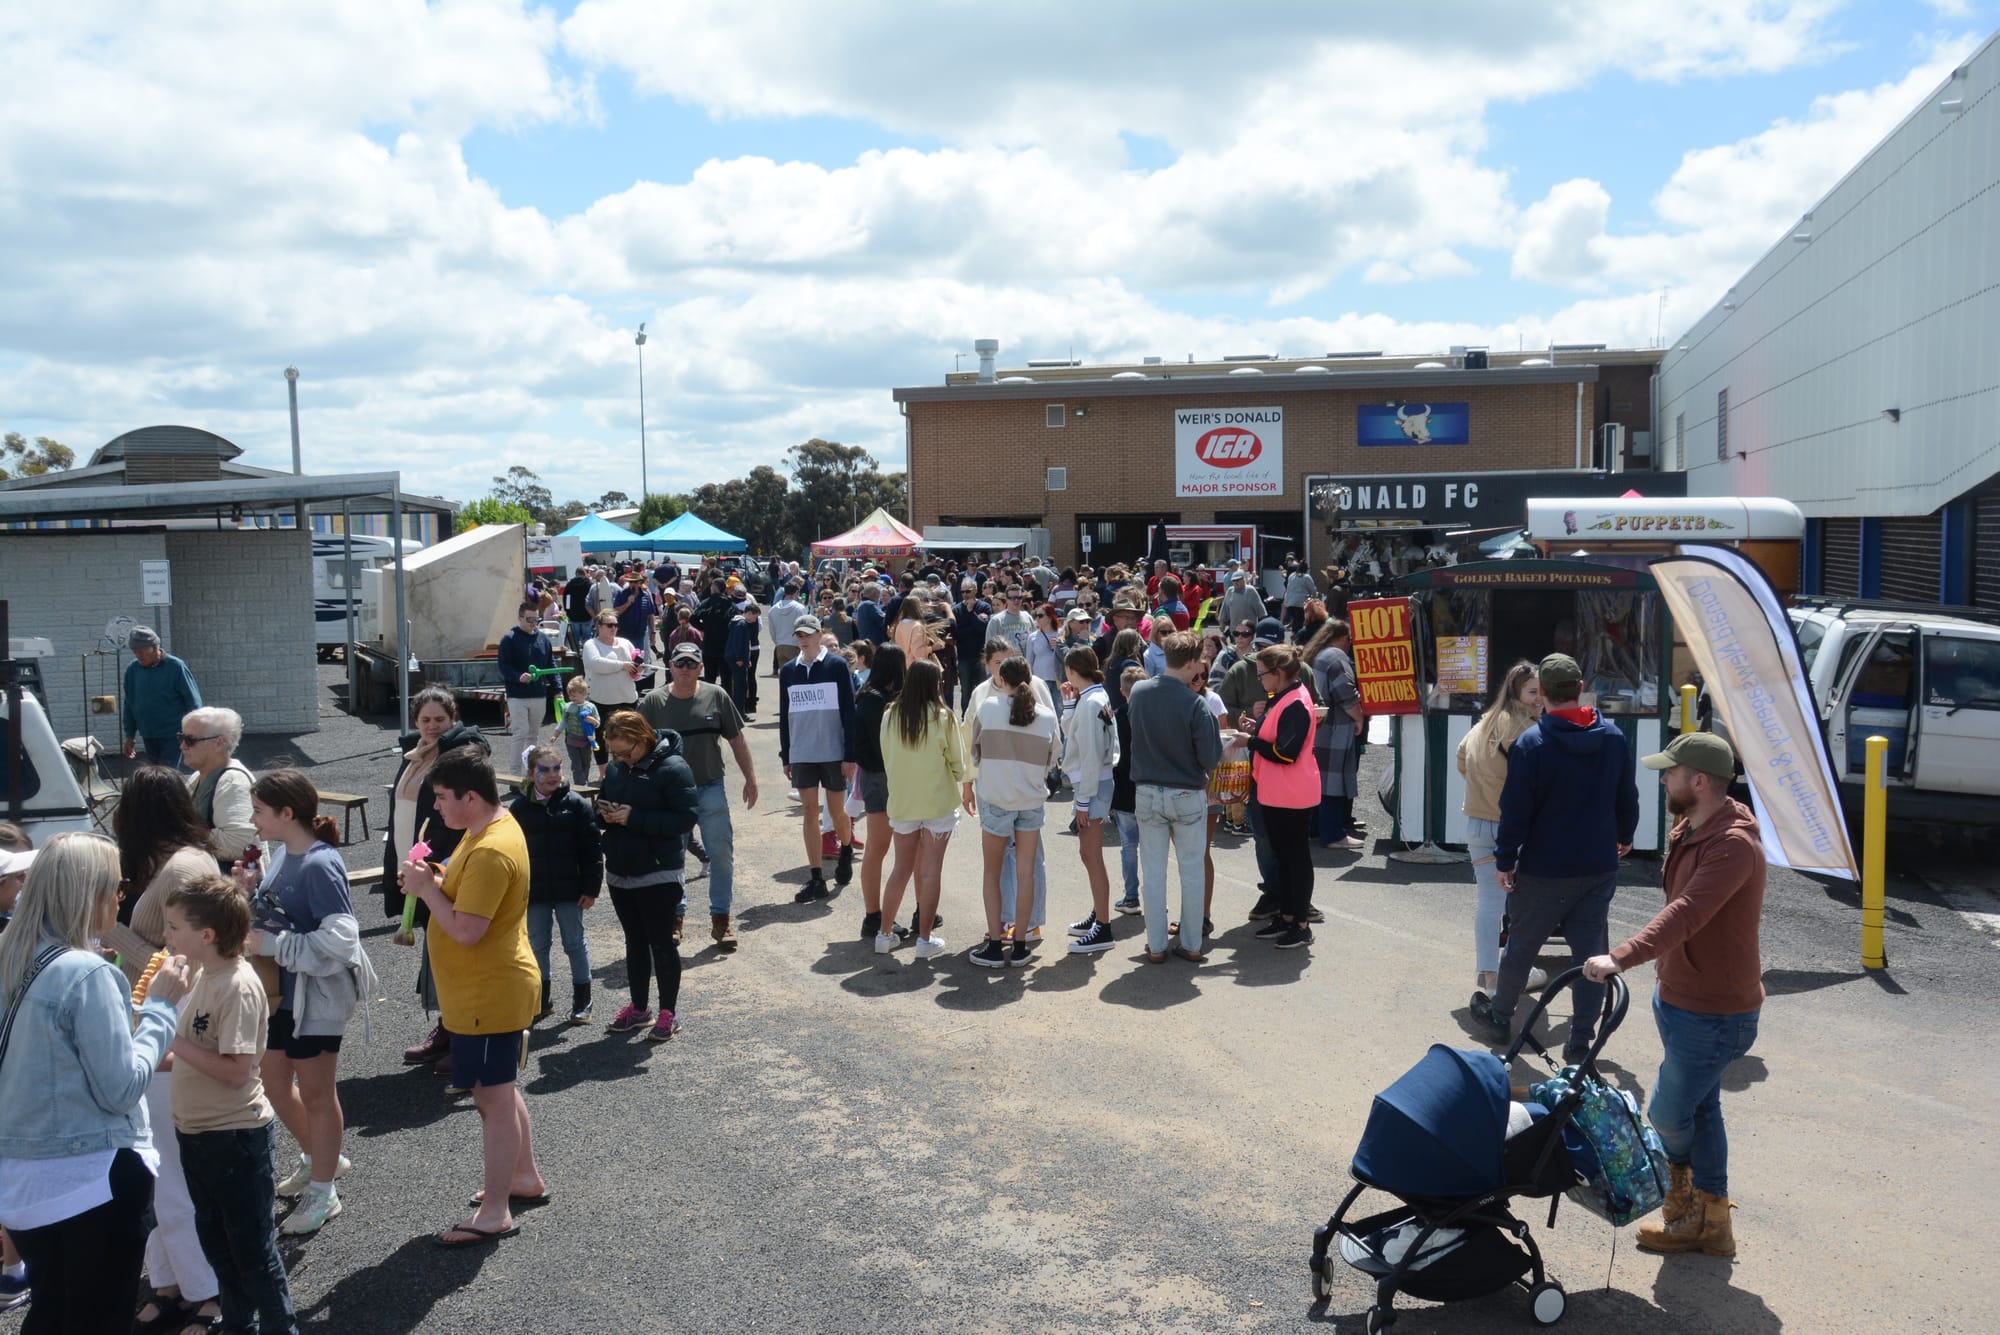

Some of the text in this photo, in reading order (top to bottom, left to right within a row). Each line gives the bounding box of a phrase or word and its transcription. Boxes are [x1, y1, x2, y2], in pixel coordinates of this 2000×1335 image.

[1178, 411, 1281, 424] WEIR'S DONALD
[1202, 434, 1255, 459] IGA
[1182, 483, 1277, 494] MAJOR SPONSOR
[1338, 483, 1478, 510] ONALD FC
[1615, 515, 1706, 531] PUPPETS
[1454, 573, 1612, 584] GOLDEN BAKED POTATOES
[1350, 605, 1405, 640] HOT
[1356, 645, 1411, 675] BAKED
[791, 690, 816, 702] GHANDA
[1362, 678, 1416, 703] POTATOES
